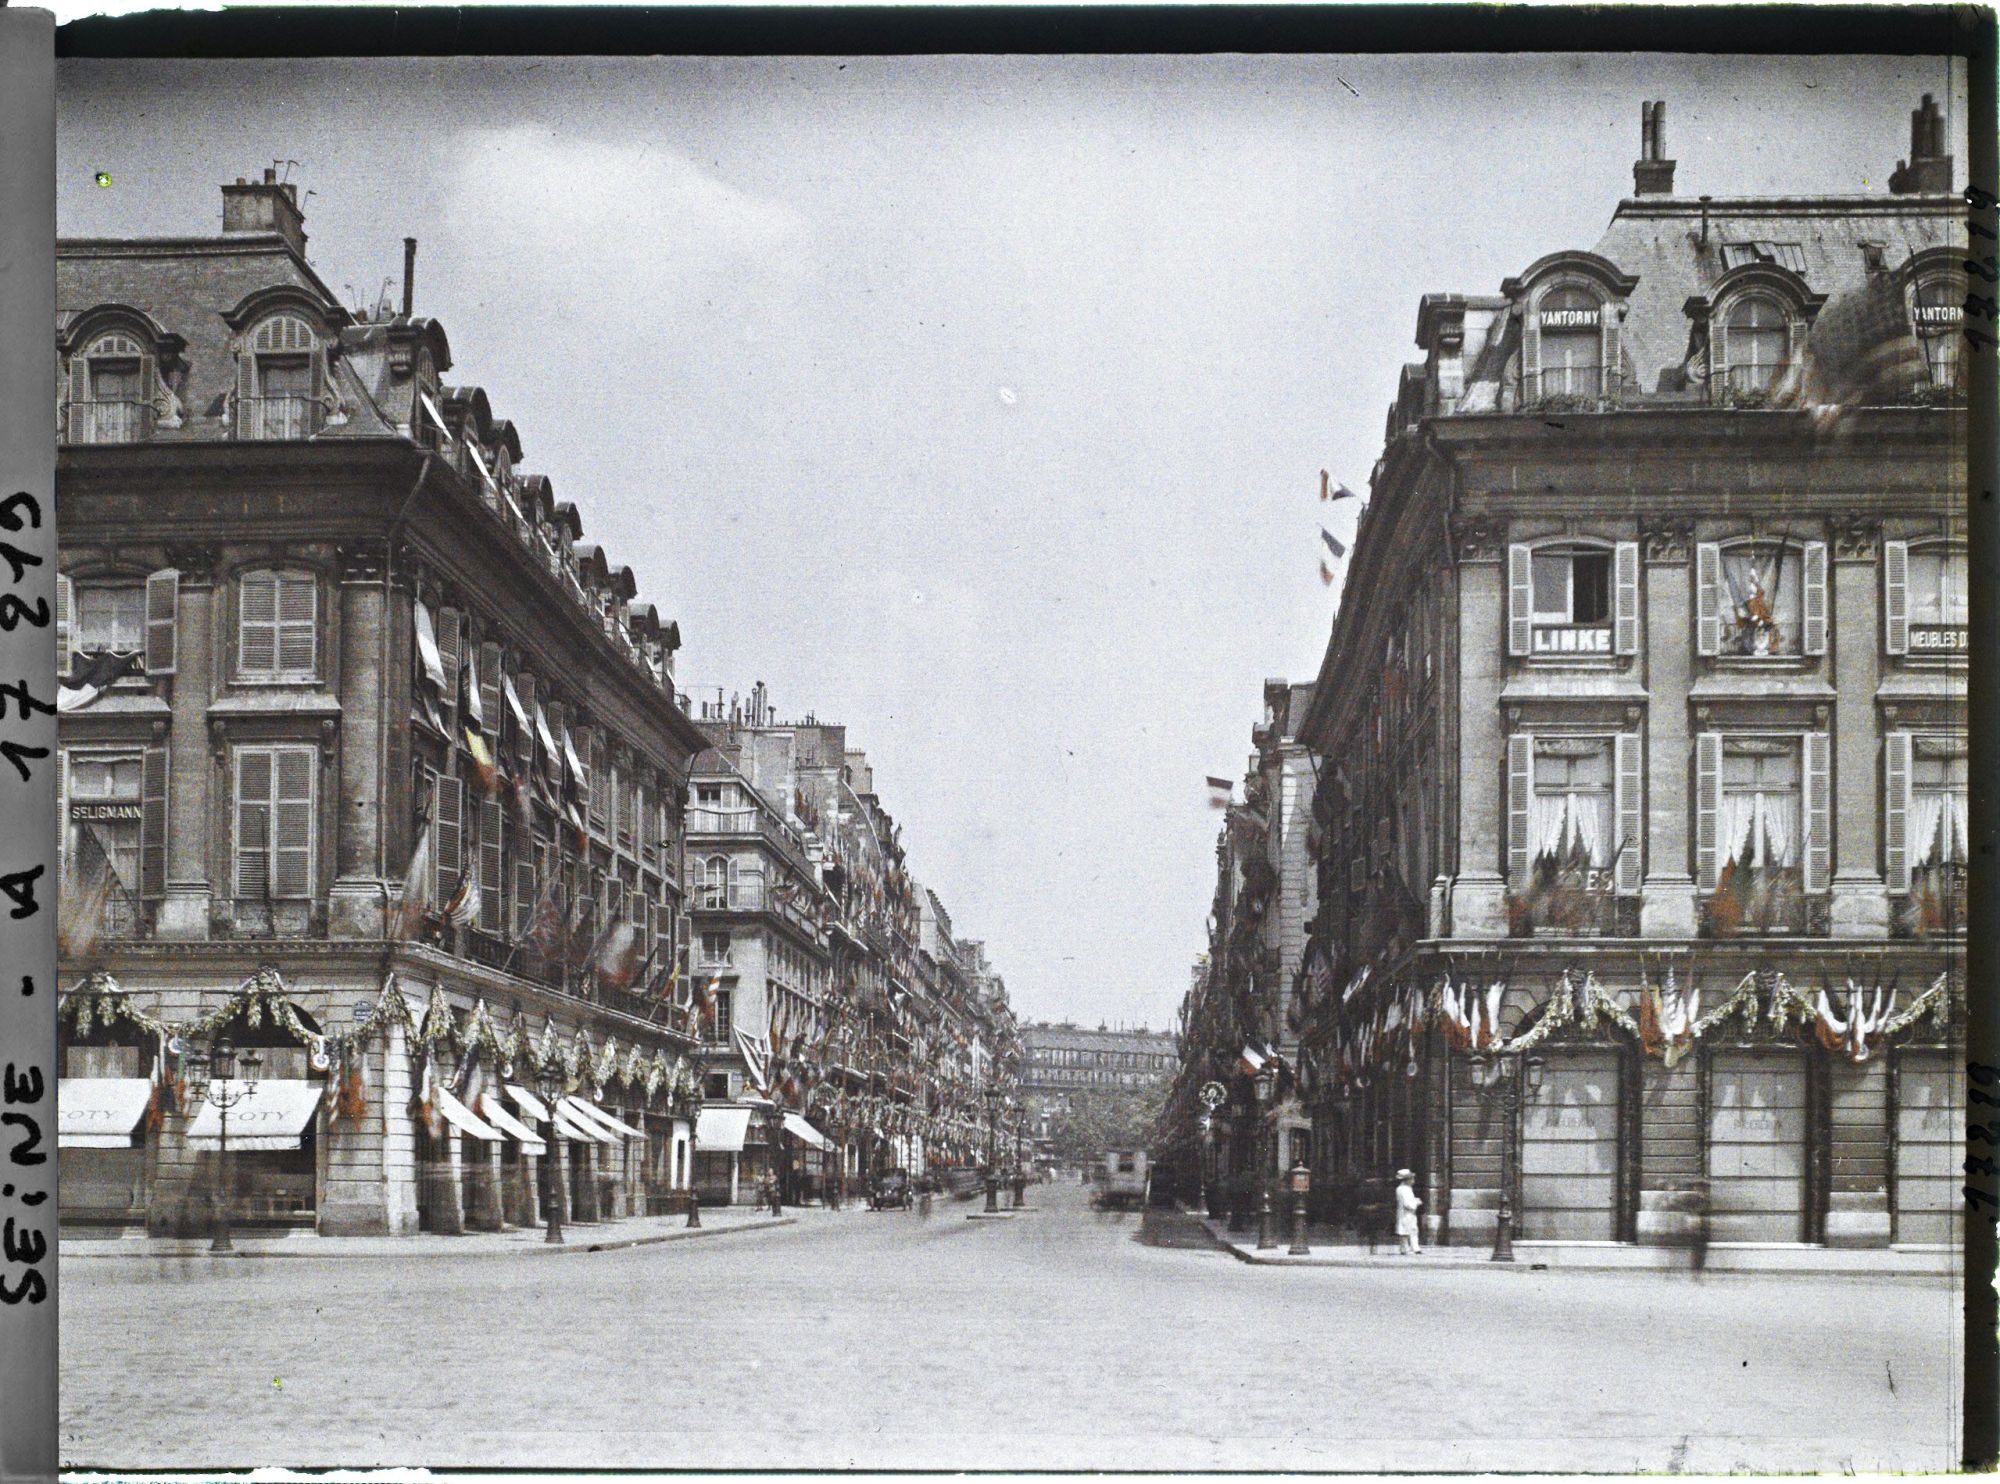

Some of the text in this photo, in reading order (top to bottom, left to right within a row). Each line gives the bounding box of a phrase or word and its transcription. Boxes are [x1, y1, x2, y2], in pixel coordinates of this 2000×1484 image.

[1541, 310, 1599, 326] YANTORNY
[1535, 629, 1611, 651] LINKE
[1911, 631, 1958, 648] MEUBLES
[72, 806, 141, 819] SELIGMANN
[0, 865, 45, 919] A
